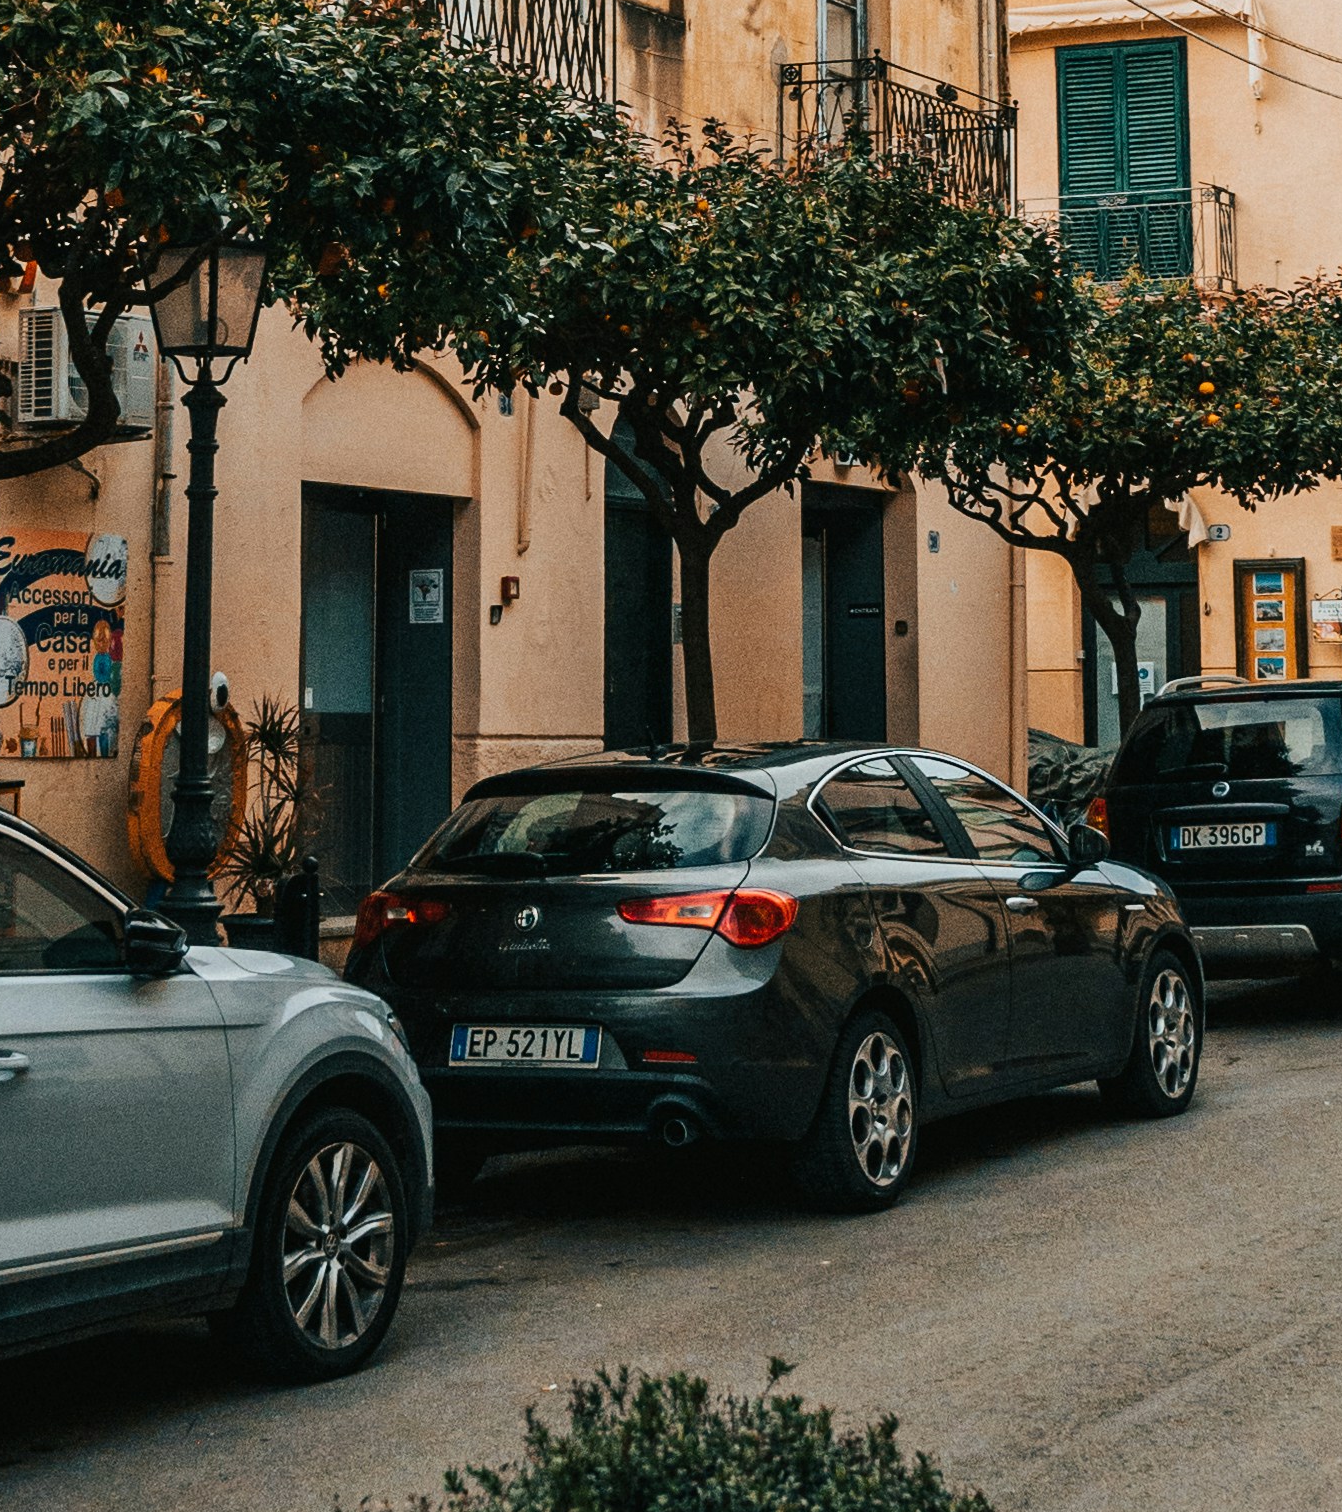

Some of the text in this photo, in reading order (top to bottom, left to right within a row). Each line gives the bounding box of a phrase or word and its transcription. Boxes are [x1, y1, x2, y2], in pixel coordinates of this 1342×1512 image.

[1216, 527, 1223, 539] 2
[9, 581, 93, 606] Accessori
[54, 609, 89, 627] per la
[35, 622, 91, 653] Casa
[48, 656, 89, 674] e per il
[5, 676, 112, 701] Tempo Libero
[1181, 827, 1202, 847] DK
[1209, 825, 1263, 846] 396GP
[468, 1029, 498, 1058] EP
[506, 1029, 580, 1059] 521YL
